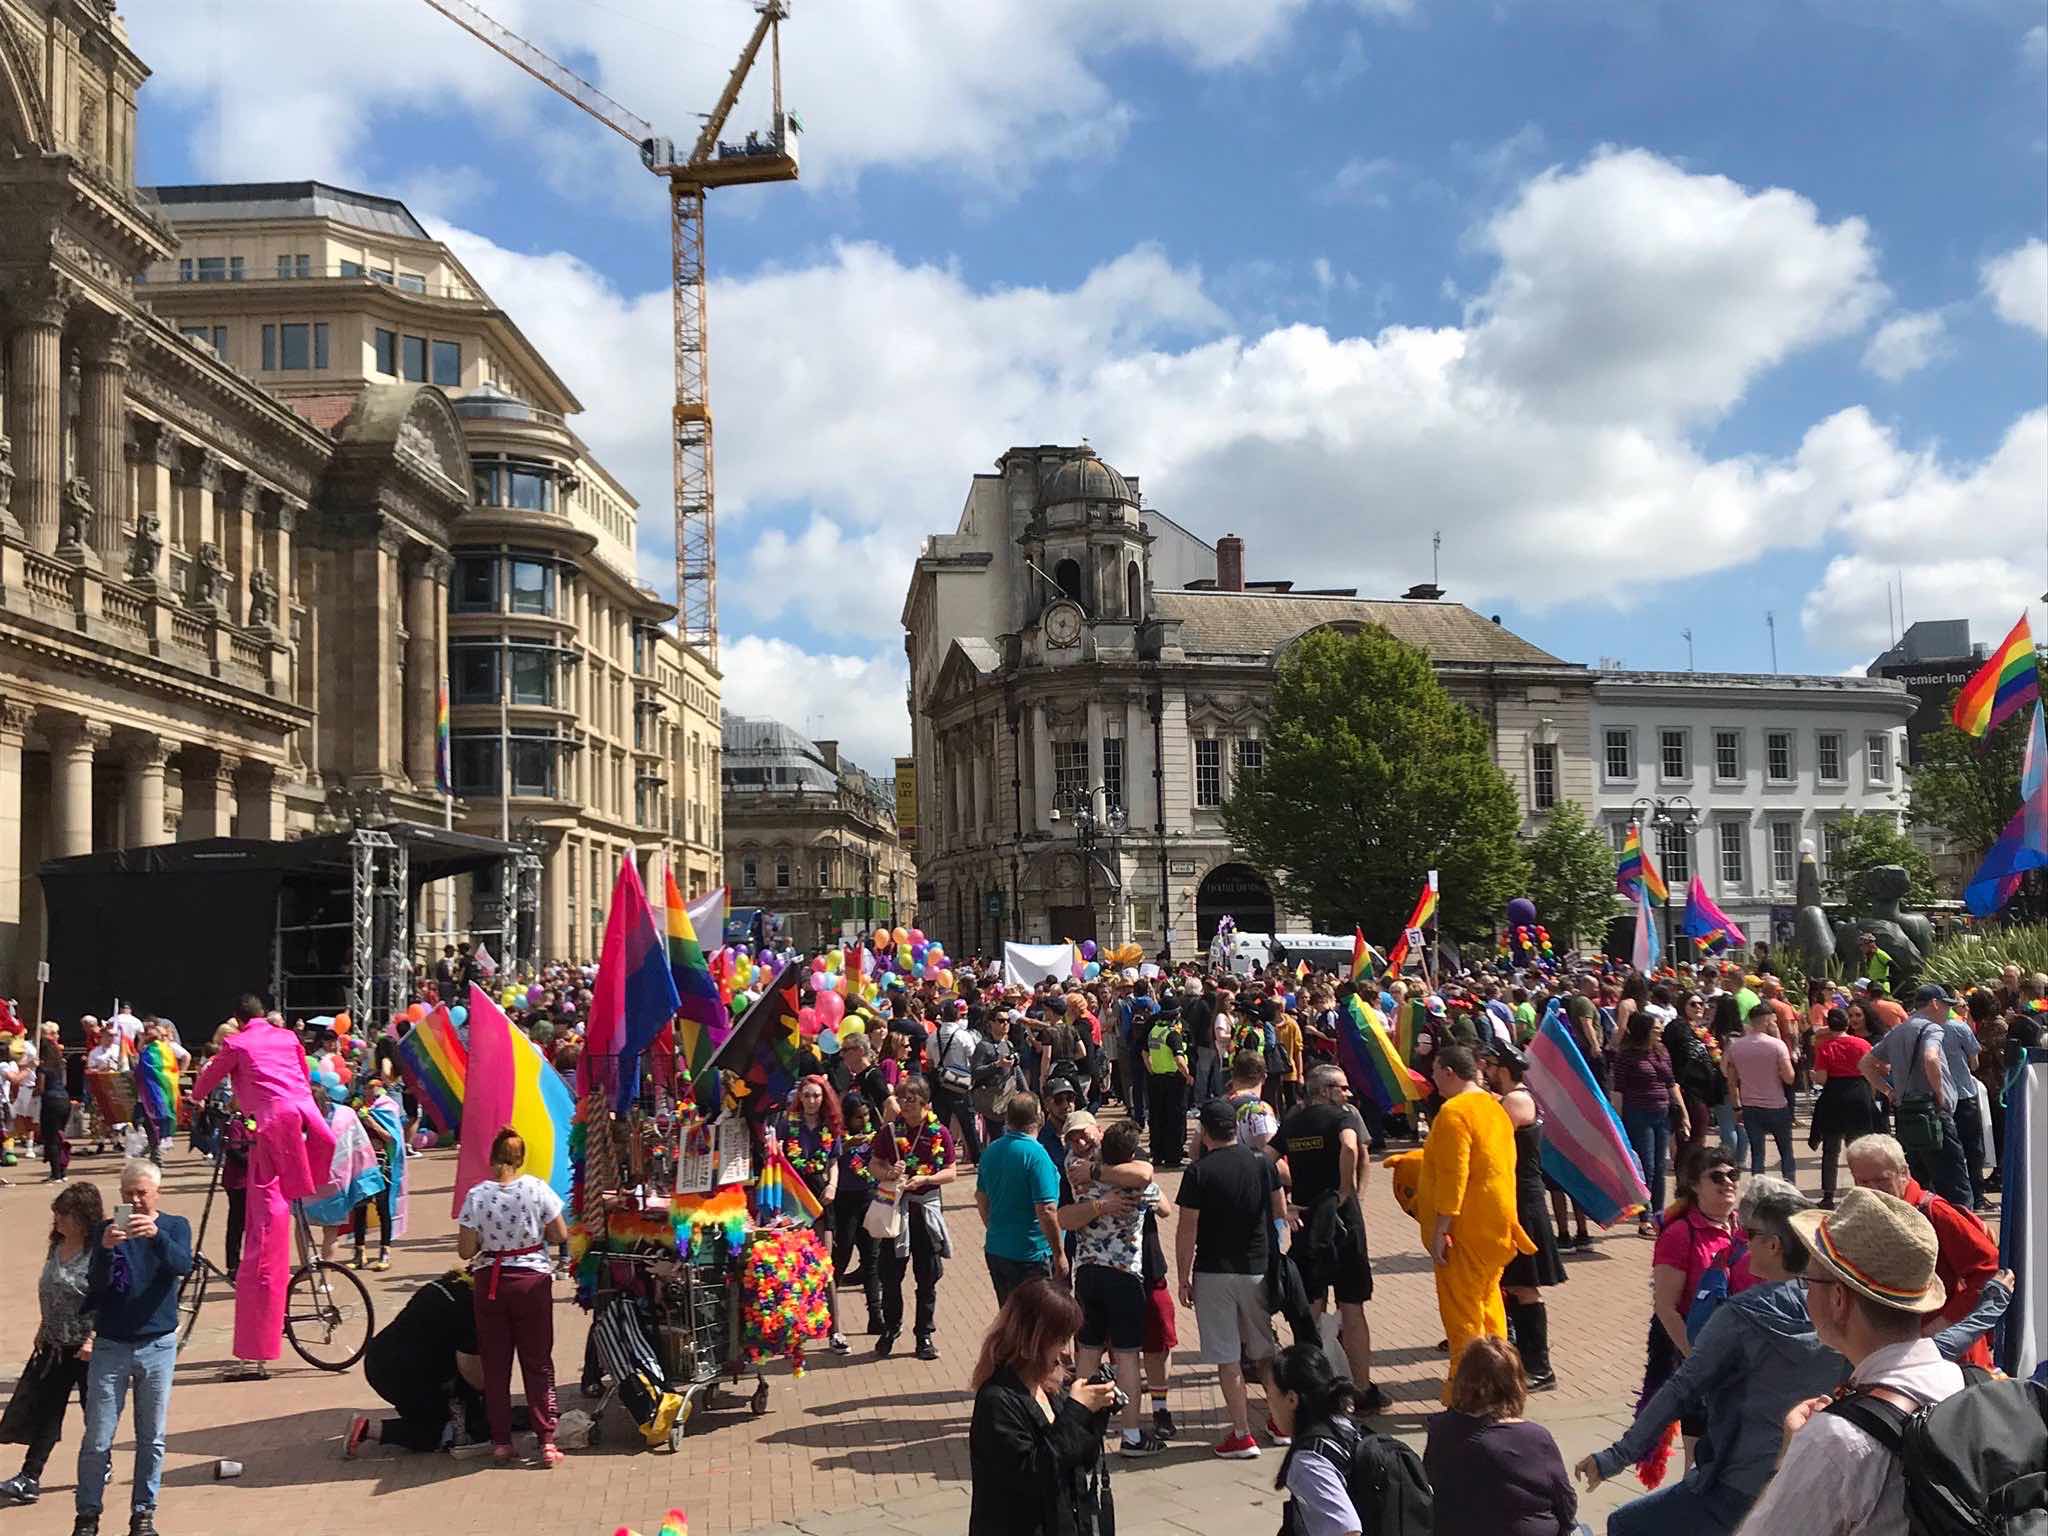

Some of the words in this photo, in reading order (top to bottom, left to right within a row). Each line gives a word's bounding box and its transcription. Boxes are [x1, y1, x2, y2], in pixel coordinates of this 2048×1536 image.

[1896, 674, 1945, 685] Premier
[1947, 673, 1966, 683] Inn
[1265, 939, 1343, 948] OLICE
